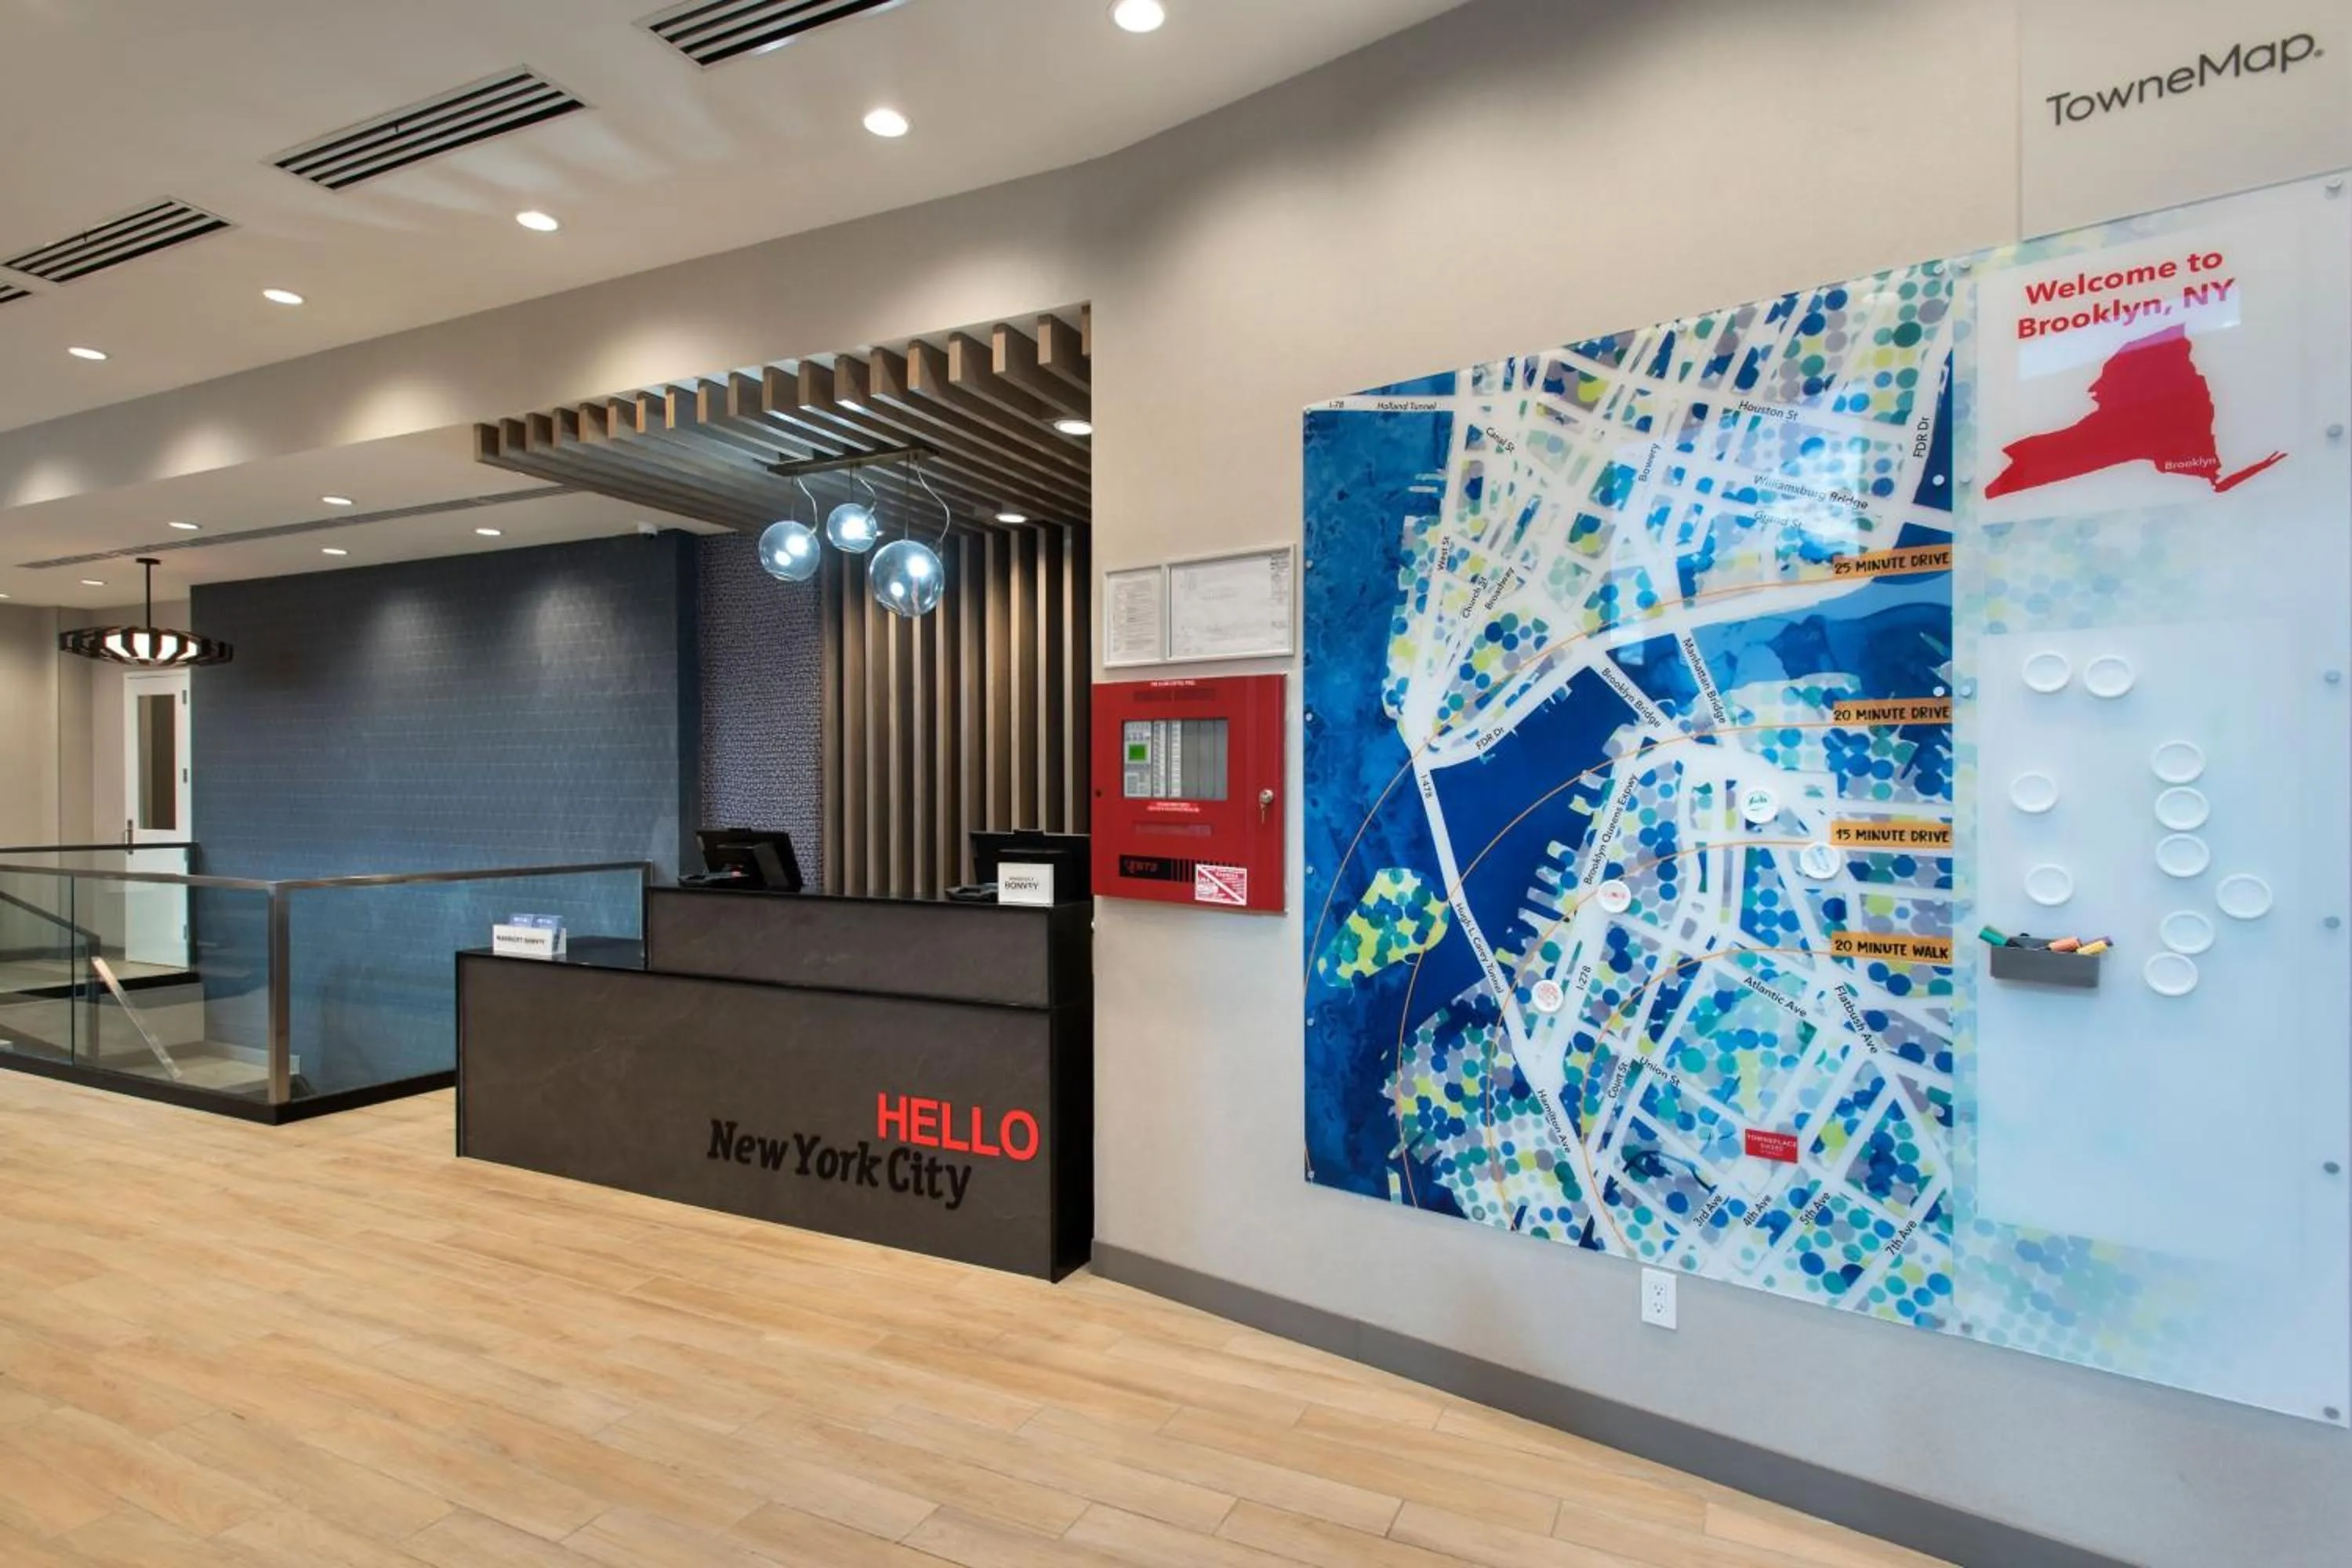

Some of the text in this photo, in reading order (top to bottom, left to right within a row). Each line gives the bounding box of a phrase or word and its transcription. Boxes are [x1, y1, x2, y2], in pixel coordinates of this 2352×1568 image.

[2026, 250, 2223, 305] Welcome to
[2017, 278, 2235, 339] Brooklyn, NY
[1377, 401, 1437, 410] Holland Tunnel
[1739, 400, 1798, 420] Houston St
[1486, 427, 1515, 452] Canal St
[1913, 416, 1929, 459] FDR Dr
[1639, 443, 1661, 482] Bowery
[2164, 456, 2216, 471] Brooklyn
[1830, 492, 1868, 509] Bridge
[1835, 552, 1949, 574] 25 MINUTE DRIVE
[1462, 587, 1481, 618] Church
[1485, 567, 1515, 610] Broadway
[1602, 667, 1661, 728] Brooklyn Bridge
[1683, 637, 1726, 724] Manhattan Bridge
[1834, 706, 1950, 720] 20 MINUTE DRIVE
[1475, 726, 1504, 750] FDR Dr
[1584, 845, 1606, 885] Brooklyn
[1602, 806, 1624, 843] Queens
[1837, 828, 1949, 843] 15 MINUTE DRIVE
[1456, 902, 1472, 927] Hugh
[1474, 937, 1488, 962] Carey
[1486, 963, 1504, 993] Tunnel
[1835, 939, 1949, 959] 20 MINUTE WALK
[1576, 965, 1591, 989] I-278
[1743, 976, 1807, 1017] Atlantic Ave
[1835, 985, 1878, 1054] Flatbush Ave
[1608, 1062, 1628, 1098] Court St
[1640, 1056, 1681, 1086] Union St
[877, 1092, 1039, 1161] HELLO
[1537, 1089, 1571, 1152] Hamilton Ave
[1693, 1194, 1723, 1228] 3rd Ave
[1743, 1193, 1772, 1228] 4th Ave
[1800, 1192, 1831, 1225] 5th Ave
[1886, 1219, 1917, 1256] 7th Ave
